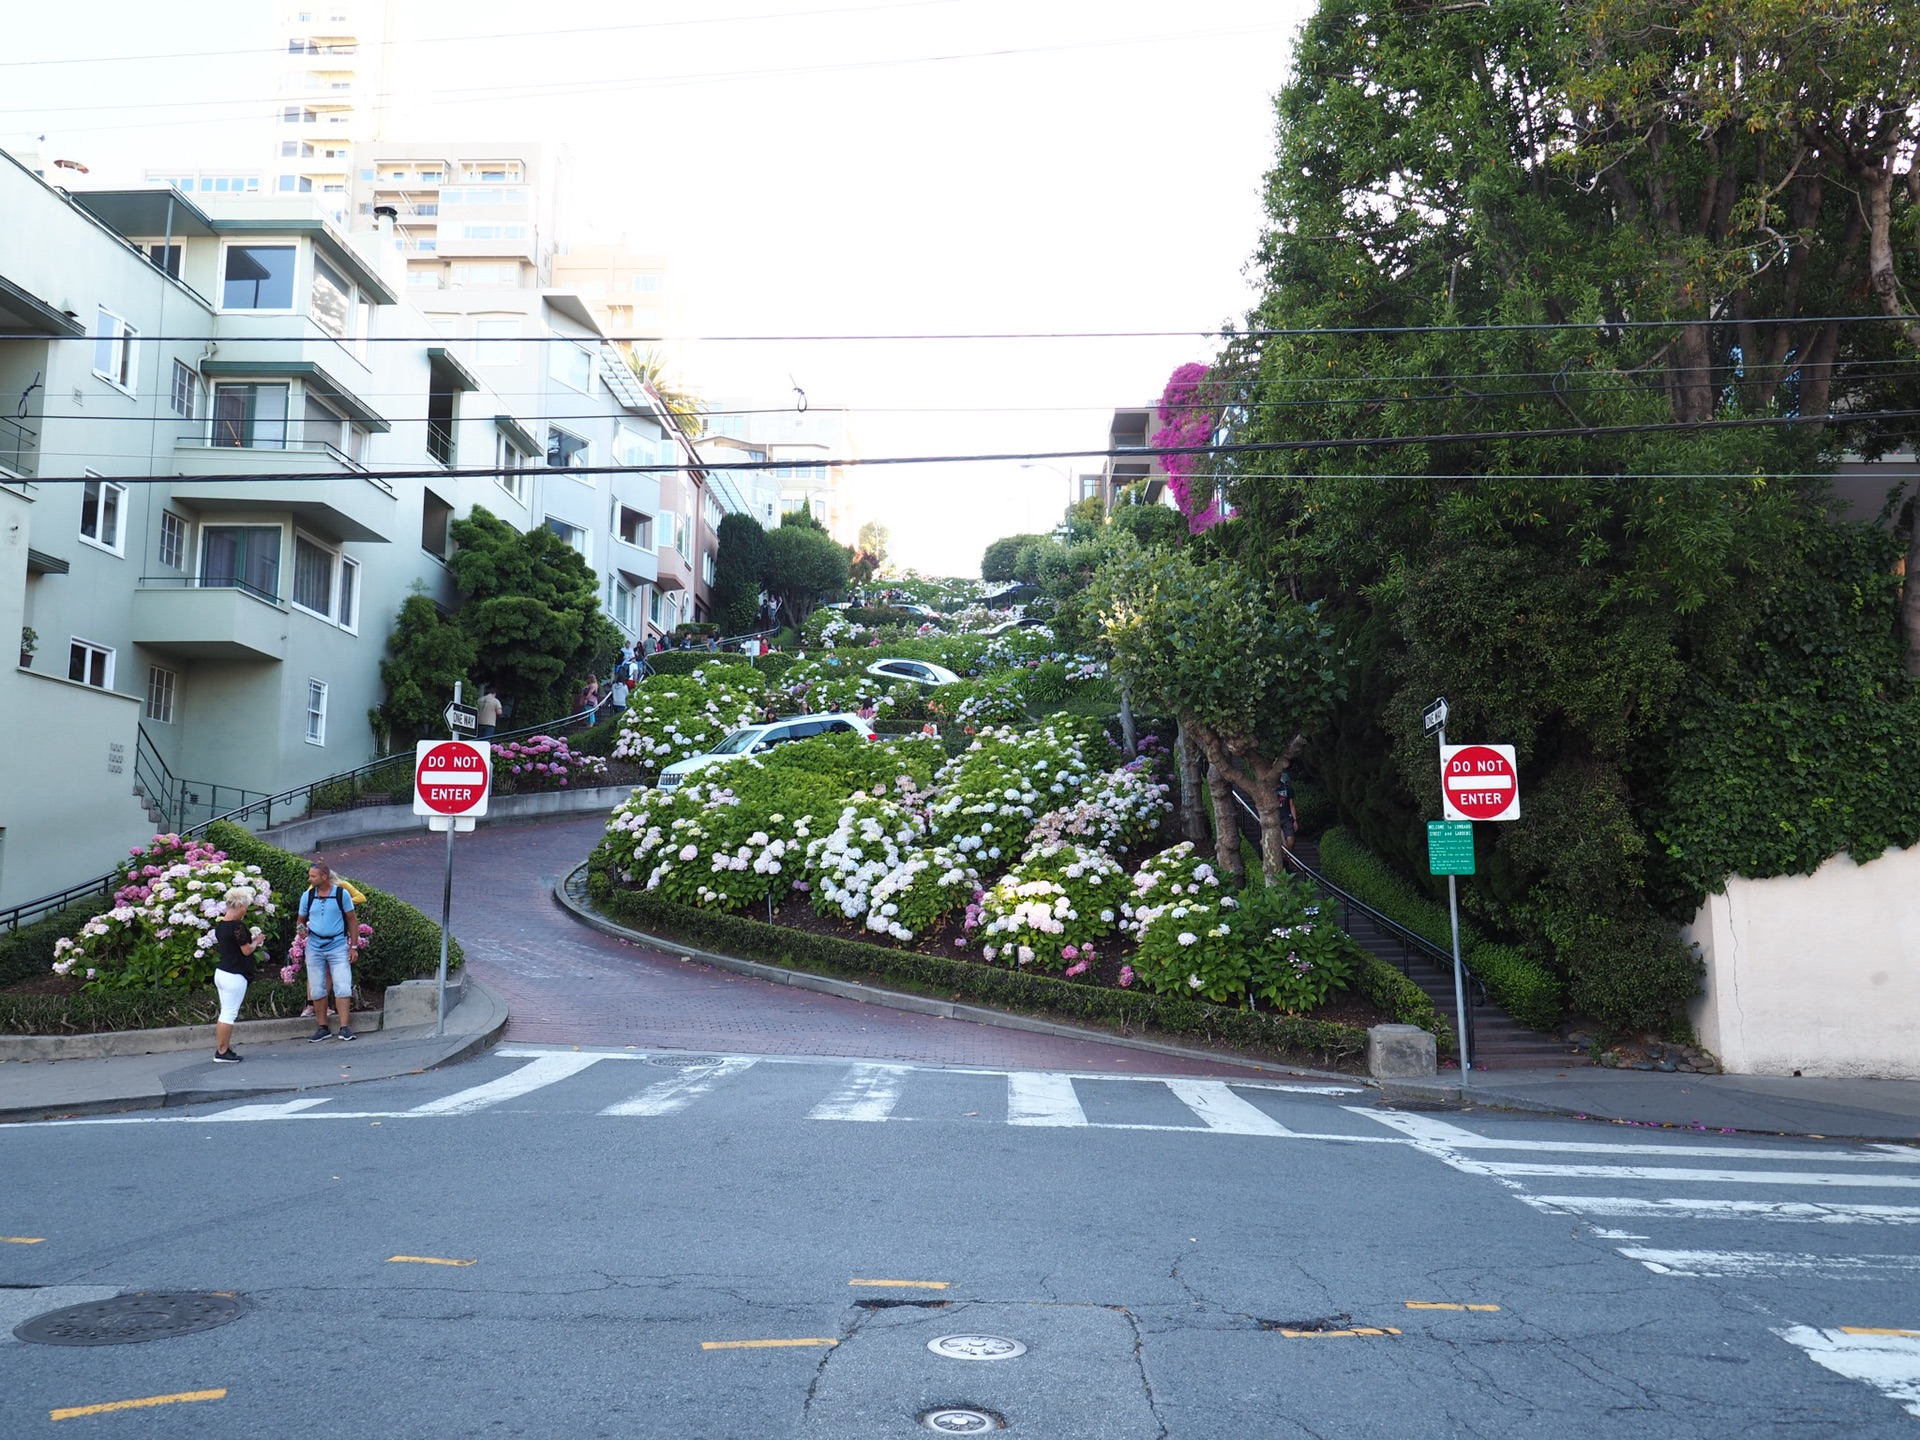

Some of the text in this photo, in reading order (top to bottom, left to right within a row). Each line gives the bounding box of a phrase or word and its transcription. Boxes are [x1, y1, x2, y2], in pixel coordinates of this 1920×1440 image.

[453, 712, 475, 727] ONE WAY
[1426, 708, 1442, 728] ONE WAY
[428, 756, 478, 768] DO NOT
[1452, 760, 1504, 773] DO NOT
[430, 788, 471, 800] ENTER
[1460, 793, 1502, 805] ENTER
